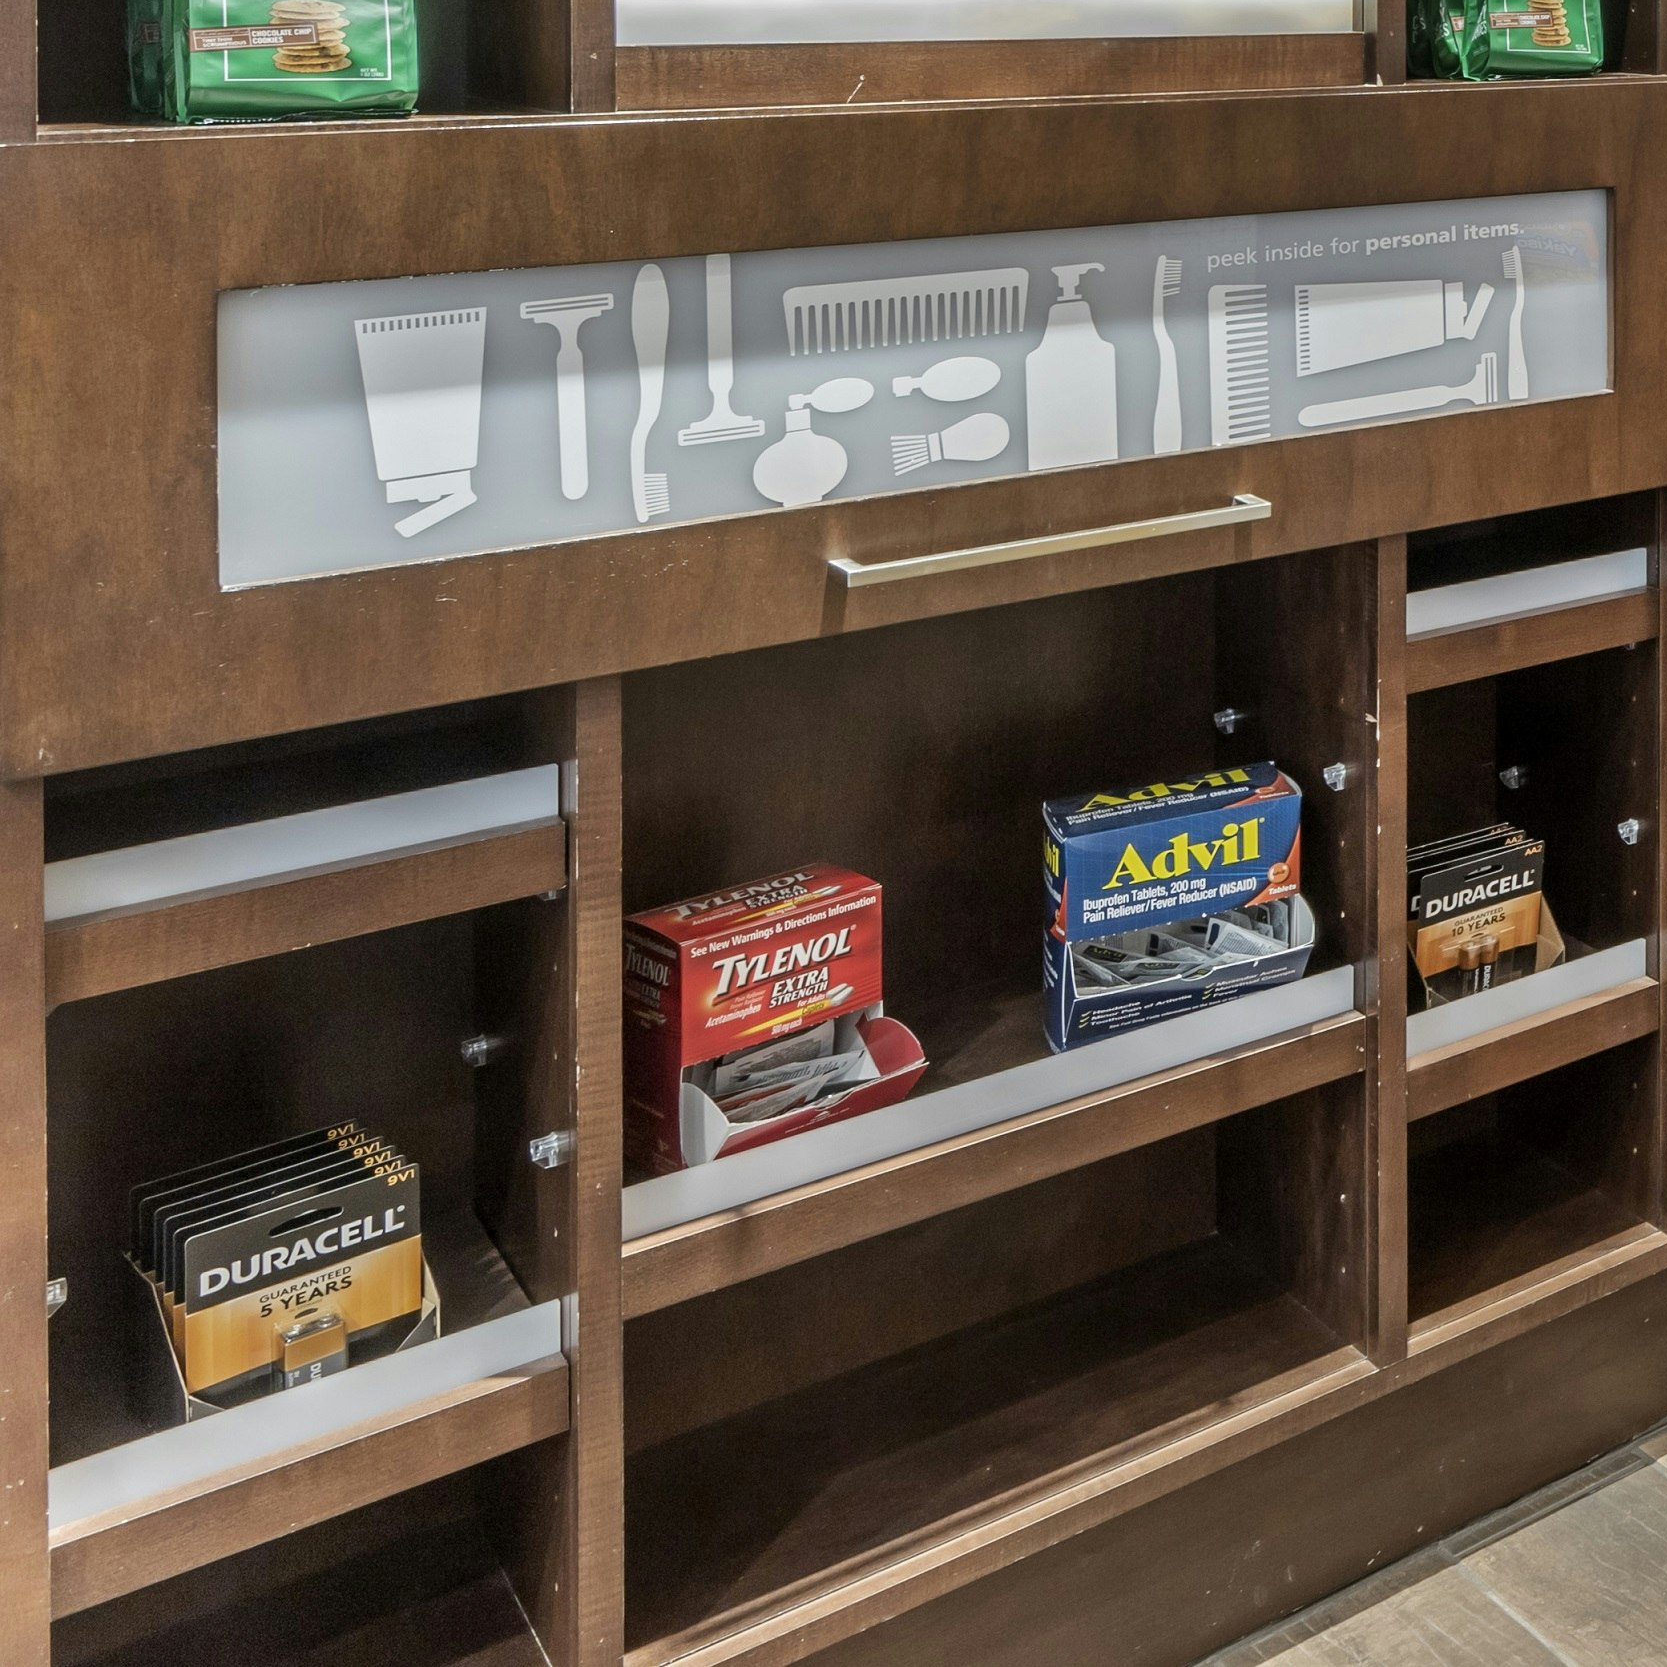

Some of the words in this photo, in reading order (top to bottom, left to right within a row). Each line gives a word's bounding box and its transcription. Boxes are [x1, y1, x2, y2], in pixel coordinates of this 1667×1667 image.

[251, 28, 293, 38] CHOCOLATE
[294, 27, 312, 37] CHIP
[251, 36, 284, 45] COOKIES
[1206, 246, 1258, 272] peek
[1265, 238, 1324, 263] inside
[1330, 235, 1361, 255] for
[1365, 224, 1457, 256] personal
[1463, 221, 1525, 242] items.
[1075, 768, 1252, 814] Advil
[1208, 786, 1250, 798] (NSAID)
[1101, 816, 1262, 890] Advil
[1524, 844, 1543, 857] AA2
[665, 871, 815, 919] TYLENOL
[1082, 890, 1131, 912] Ibuprofen
[1130, 884, 1169, 903] Tablets,
[1170, 881, 1190, 893] 200
[1189, 878, 1207, 893] mg
[1082, 908, 1104, 924] Pain
[1105, 895, 1178, 920] Reliever/Fever
[1178, 887, 1218, 906] Reducer
[1218, 876, 1258, 898] (NSAID)
[1267, 883, 1297, 896] Tablets
[1425, 868, 1535, 919] DURACELL
[690, 945, 708, 959] See
[708, 940, 730, 954] New
[732, 929, 775, 949] Warnings
[784, 910, 827, 933] Directions
[828, 895, 877, 919] Information
[1451, 922, 1465, 938] 10
[1467, 912, 1506, 934] YEARS
[1453, 906, 1504, 927] GUARANTEED
[711, 926, 852, 997] TYLENOL
[771, 966, 829, 998] EXTRA
[769, 982, 828, 1009] STRENGTH
[705, 1003, 763, 1029] Acetaminophen
[327, 1122, 355, 1141] 9V1
[338, 1133, 365, 1151] 9V1
[353, 1141, 381, 1159] 9V1
[364, 1150, 392, 1168] 9V1
[374, 1159, 402, 1177] 9V1
[387, 1168, 416, 1186] 9V1
[199, 1206, 406, 1299] DURACELL
[259, 1265, 352, 1304] GUARANTEED
[260, 1303, 273, 1319] 5
[280, 1277, 353, 1311] YEARS
